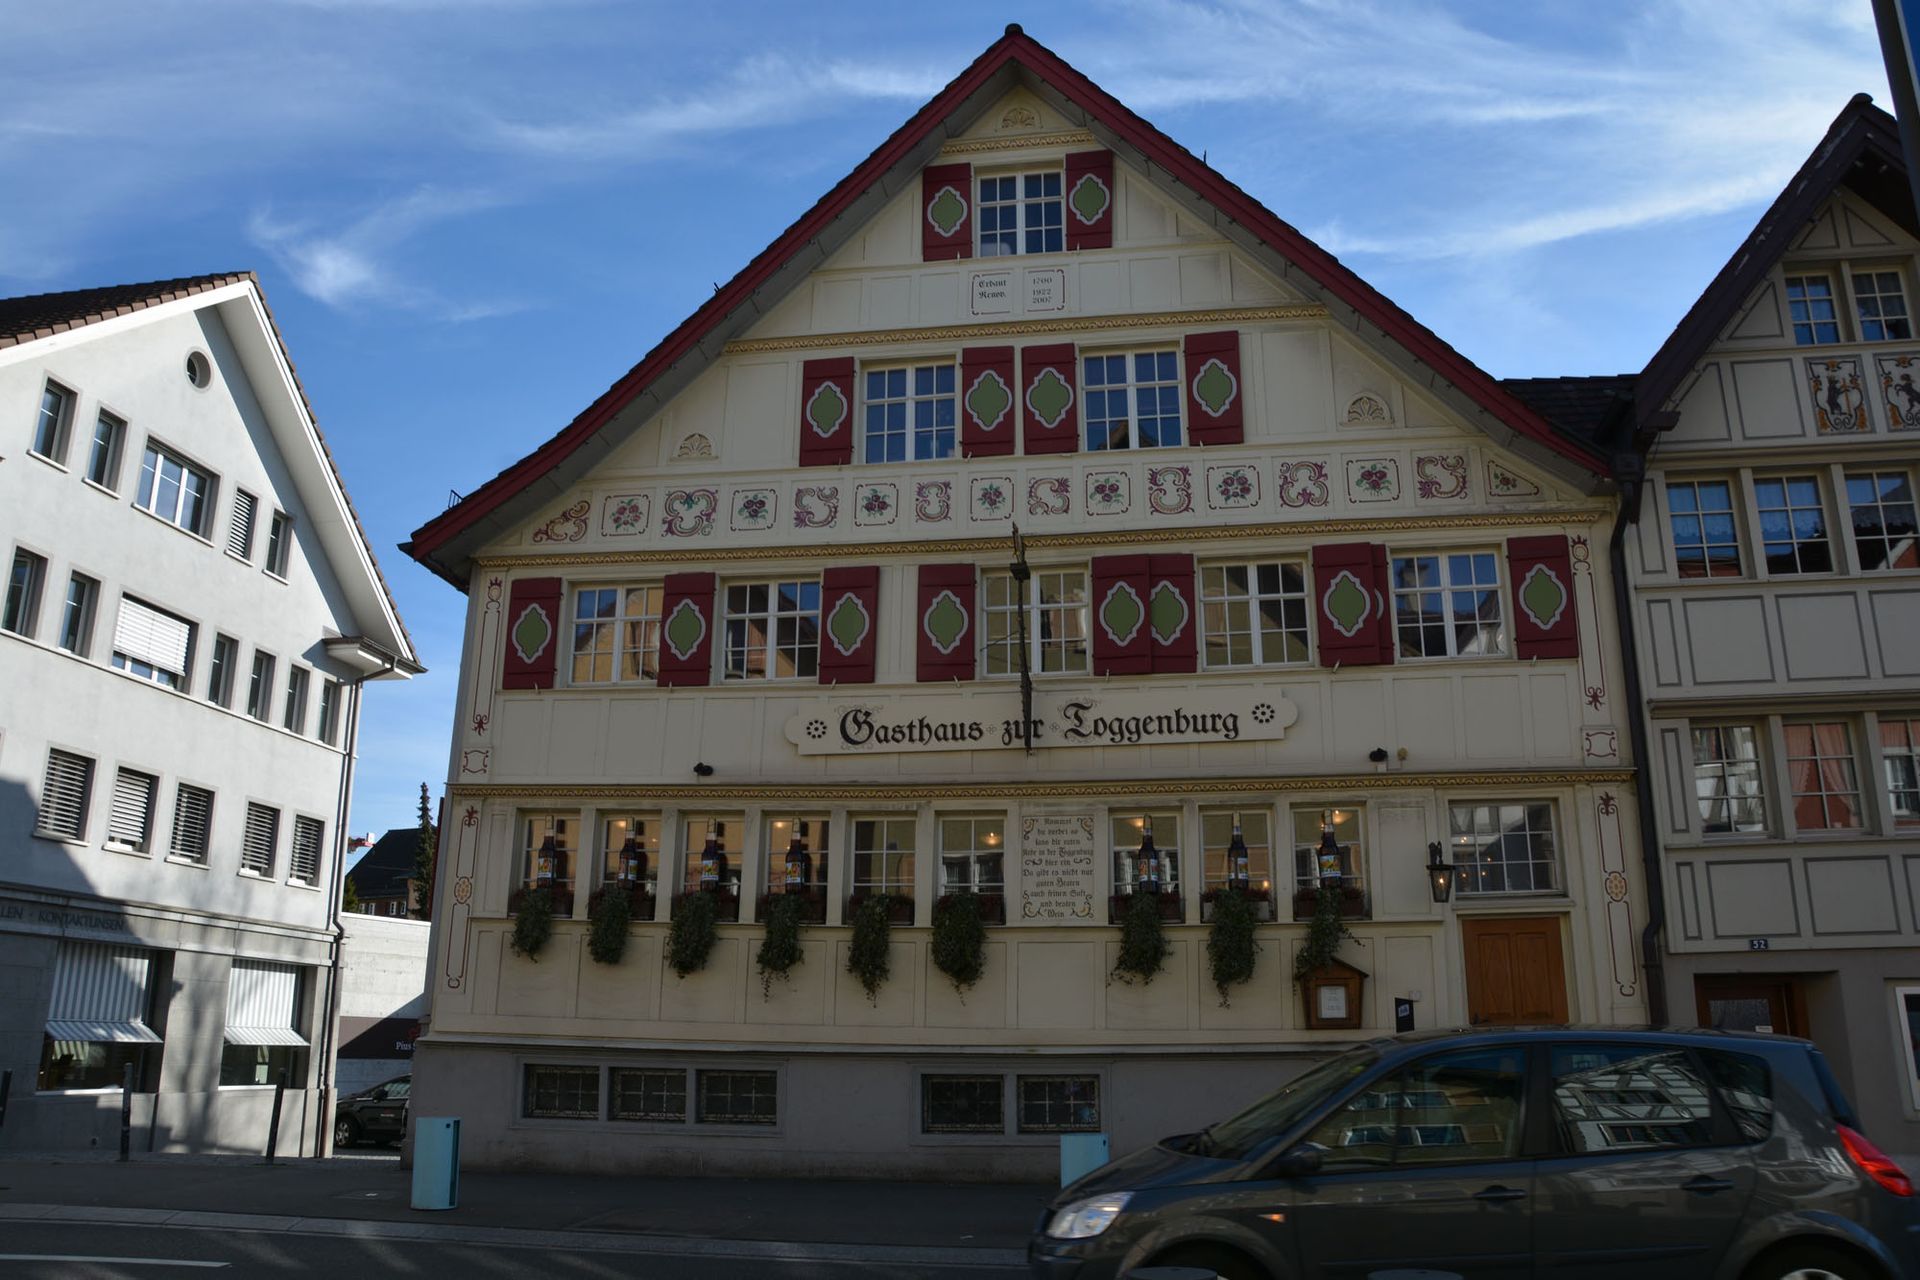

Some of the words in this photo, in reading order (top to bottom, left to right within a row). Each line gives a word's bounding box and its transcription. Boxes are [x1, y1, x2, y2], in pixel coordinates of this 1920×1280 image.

[839, 708, 984, 746] Gasthaus
[1001, 719, 1044, 746] zur
[1063, 702, 1240, 743] Toggenburg
[38, 910, 125, 931] KONTAKTLINSEN
[395, 1041, 411, 1050] Pius
